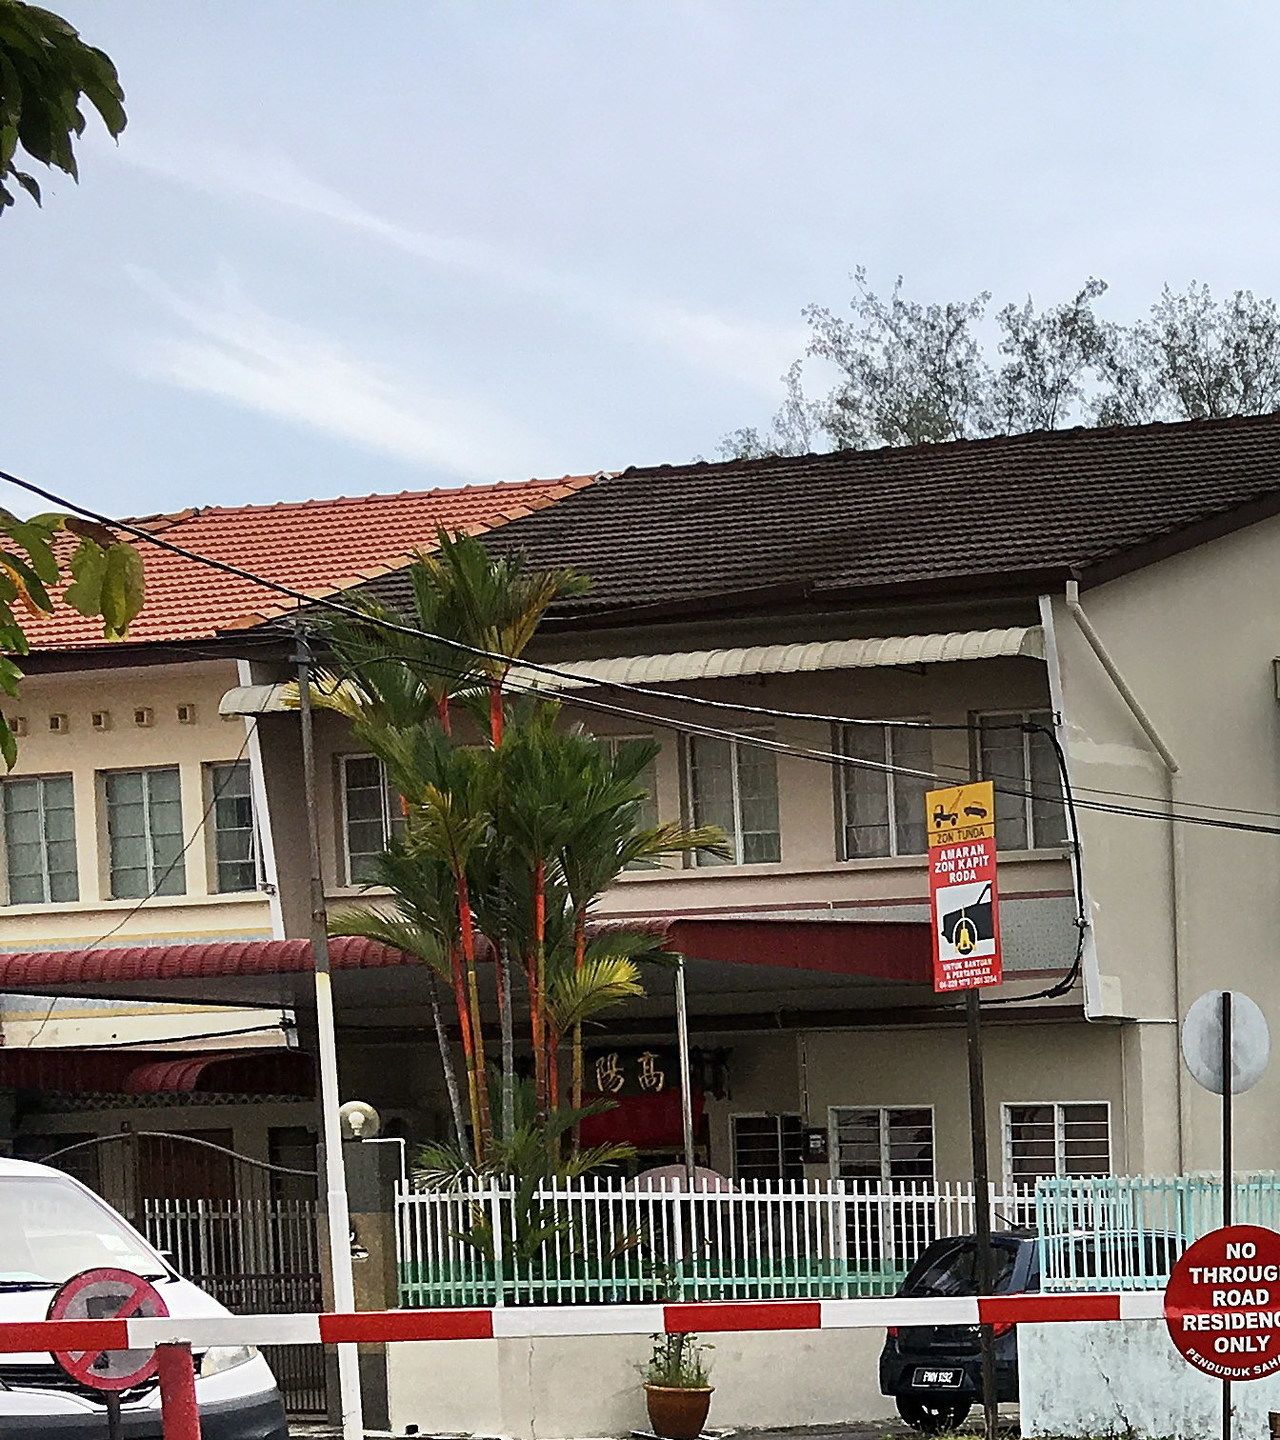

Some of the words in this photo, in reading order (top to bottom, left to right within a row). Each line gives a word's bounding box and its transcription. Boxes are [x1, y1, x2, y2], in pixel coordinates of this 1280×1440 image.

[937, 832, 953, 844] ZON
[958, 827, 985, 839] TUNDA
[940, 844, 985, 861] AMARAN
[935, 861, 955, 874] ZON
[958, 855, 990, 870] KAPIT
[949, 870, 977, 883] RODA
[1226, 1243, 1257, 1260] NO
[1212, 1289, 1270, 1307] ROAD
[1214, 1335, 1271, 1353] ONLY
[1186, 1347, 1251, 1377] PENDUDUK
